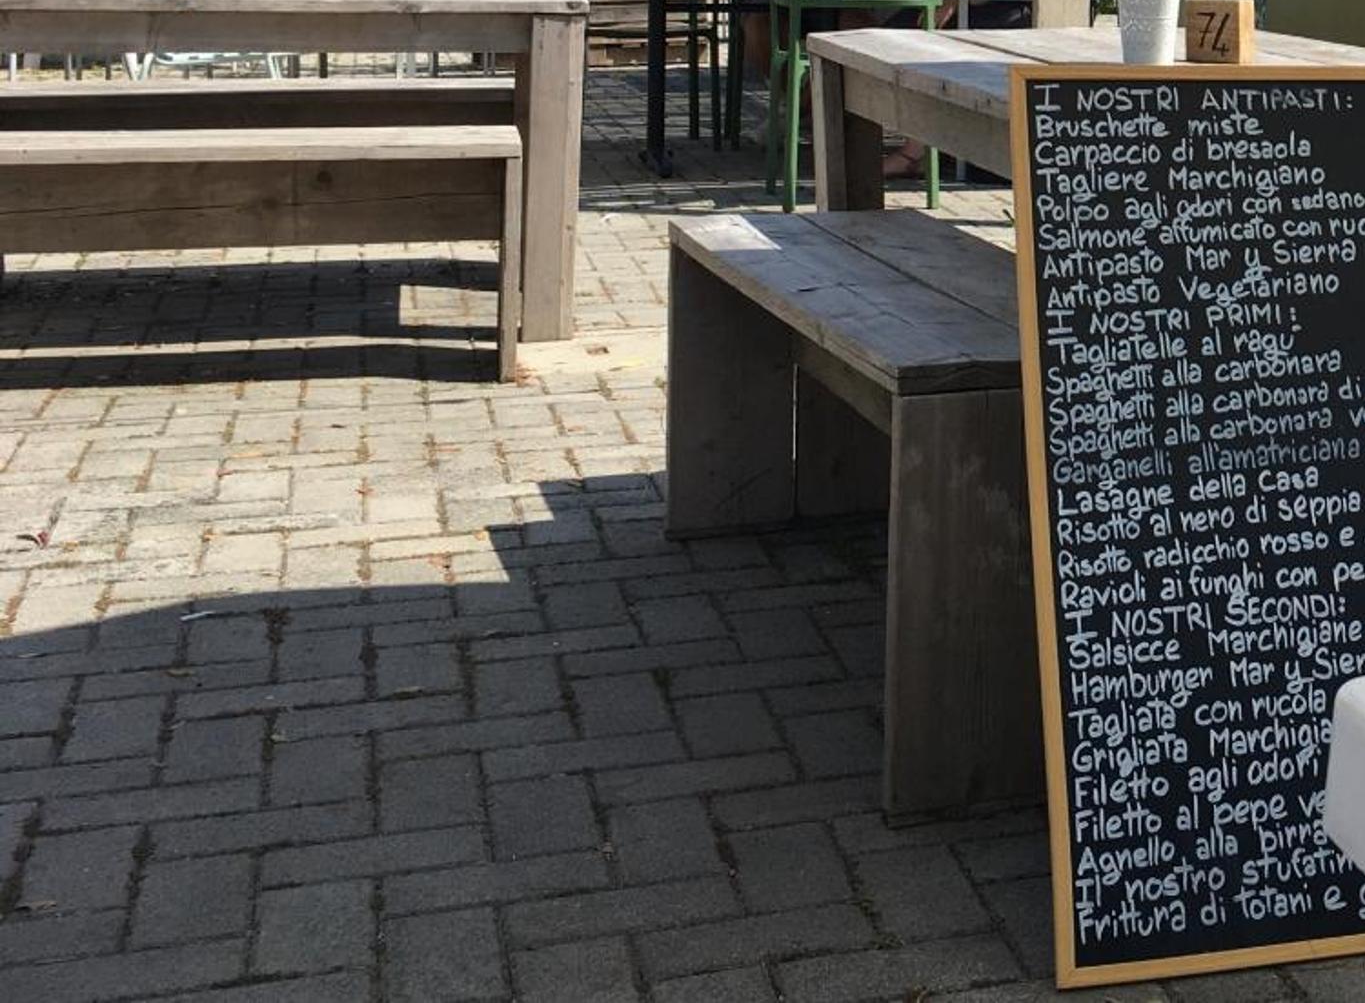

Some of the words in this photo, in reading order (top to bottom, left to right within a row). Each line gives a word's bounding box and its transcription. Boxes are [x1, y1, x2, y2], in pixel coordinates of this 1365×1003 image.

[1034, 84, 1061, 111] I
[1077, 86, 1179, 112] NOSTRI
[1201, 87, 1353, 111] ANTIPASTI:
[1034, 141, 1161, 169] Carpaccio
[1171, 138, 1194, 162] di
[1207, 130, 1311, 161] bresaola
[1035, 112, 1170, 139] Bruschette
[1188, 111, 1263, 136] miste
[1036, 167, 1150, 202] Tagliere
[1168, 161, 1326, 197] Marchigiano
[1036, 196, 1109, 228] Polpo
[1124, 194, 1169, 229] agli
[1177, 195, 1233, 220] odori
[1242, 194, 1282, 215] con
[1291, 188, 1365, 211] sedano
[1038, 223, 1147, 252] Salmone
[1159, 214, 1276, 246] affumicato
[1282, 219, 1323, 238] con
[1043, 247, 1164, 284] Antipasto
[1185, 245, 1231, 272] Mar
[1244, 246, 1272, 280] y
[1273, 240, 1357, 265] Sierra
[1047, 276, 1160, 312] Antipasto
[1178, 273, 1340, 307] Vegetariano
[1046, 309, 1075, 335] I
[1089, 307, 1191, 335] NOSTRI
[1046, 362, 1153, 402] Spaghetti
[1161, 358, 1201, 388] alla
[1214, 349, 1341, 383] carbonara
[1047, 335, 1188, 373] Tagliatelle
[1200, 331, 1222, 356] al
[1049, 393, 1155, 431] Spaghetti
[1166, 390, 1204, 417] alla
[1213, 381, 1329, 413] carbonara
[1338, 377, 1361, 399] di
[1049, 424, 1154, 460] Spaghetti
[1164, 419, 1200, 446] alla
[1210, 407, 1333, 440] carbonara
[1053, 451, 1173, 490] Garganelli
[1187, 437, 1360, 473] all'amatriciana
[1057, 484, 1174, 520] Lasagne
[1190, 472, 1246, 501] della
[1057, 516, 1140, 547] Risotto
[1150, 508, 1171, 537] al
[1180, 506, 1235, 533] nero
[1246, 496, 1267, 524] di
[1277, 489, 1361, 526] seppia
[1057, 545, 1132, 580] Risotto
[1144, 538, 1250, 568] radicchio
[1260, 531, 1329, 555] rosso
[1339, 525, 1355, 546] e
[1060, 570, 1146, 610] Ravioli
[1161, 570, 1183, 599] ai
[1188, 562, 1264, 599] funghi
[1275, 566, 1318, 589] con
[1065, 609, 1098, 641] I
[1111, 603, 1212, 638] NOSTRI
[1224, 595, 1347, 626] SECONDI:
[1069, 638, 1181, 670] Salsicce
[1208, 619, 1362, 658] Marchigiane
[1071, 665, 1212, 708] Hamburger
[1230, 657, 1274, 687] Mar
[1284, 659, 1314, 693] y
[1068, 699, 1177, 746] Tagliata
[1194, 701, 1243, 726] con
[1251, 686, 1326, 719] rucola
[1071, 732, 1188, 777] Grigliata
[1209, 719, 1333, 757] Marchigia
[1074, 774, 1169, 808] Filetto
[1188, 765, 1237, 802] agli
[1247, 749, 1321, 784] odori
[1074, 803, 1162, 842] Filetto
[1176, 794, 1198, 830] al
[1213, 794, 1286, 831] pepe
[1077, 836, 1174, 885] Agnello
[1196, 827, 1238, 860] alla
[1259, 819, 1327, 853] birra
[1125, 861, 1225, 901] nostro
[1242, 849, 1353, 885] stufatin
[1077, 901, 1186, 945] Frittura
[1200, 895, 1226, 925] di
[1234, 884, 1312, 920] totani
[1324, 885, 1347, 910] e
